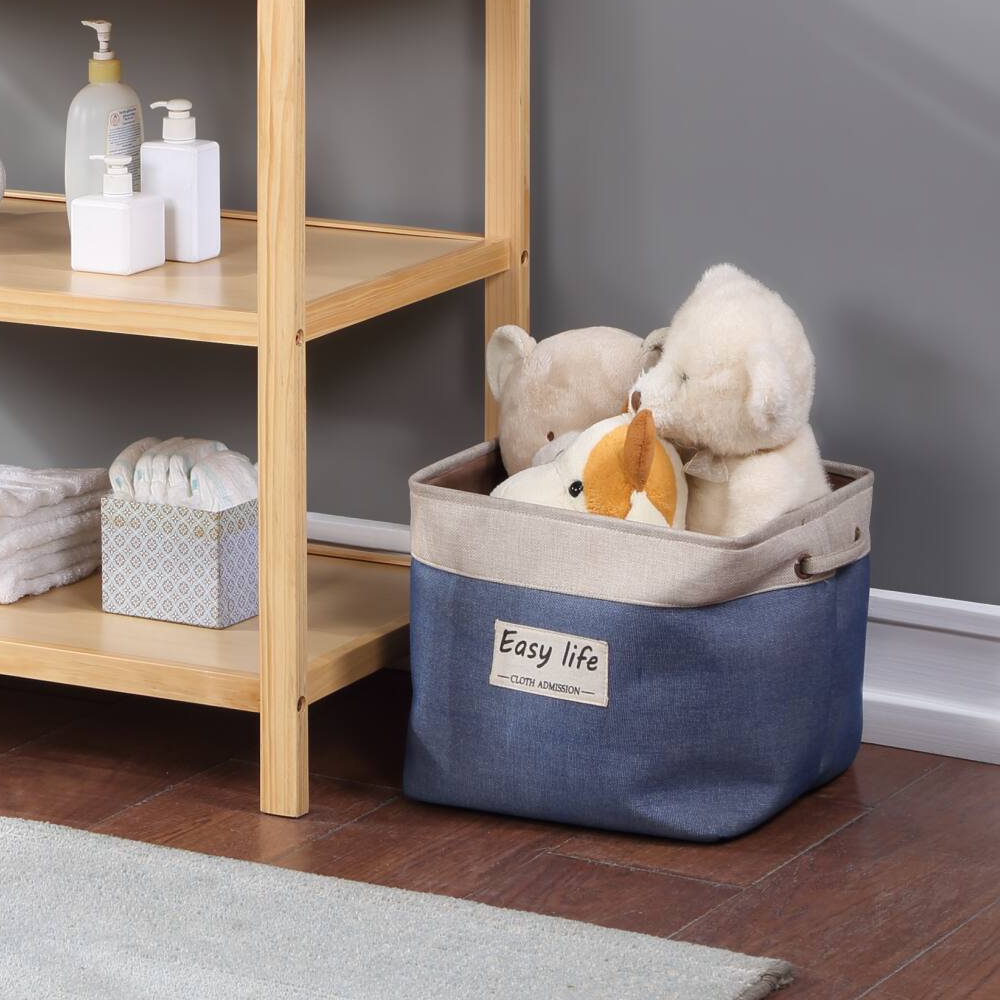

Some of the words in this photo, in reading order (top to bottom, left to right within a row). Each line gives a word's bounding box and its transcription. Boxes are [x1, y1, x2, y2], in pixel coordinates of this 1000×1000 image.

[499, 629, 552, 668] Easy
[562, 641, 598, 671] life
[510, 674, 535, 687] CLOTH
[537, 680, 581, 695] ADMISSION
